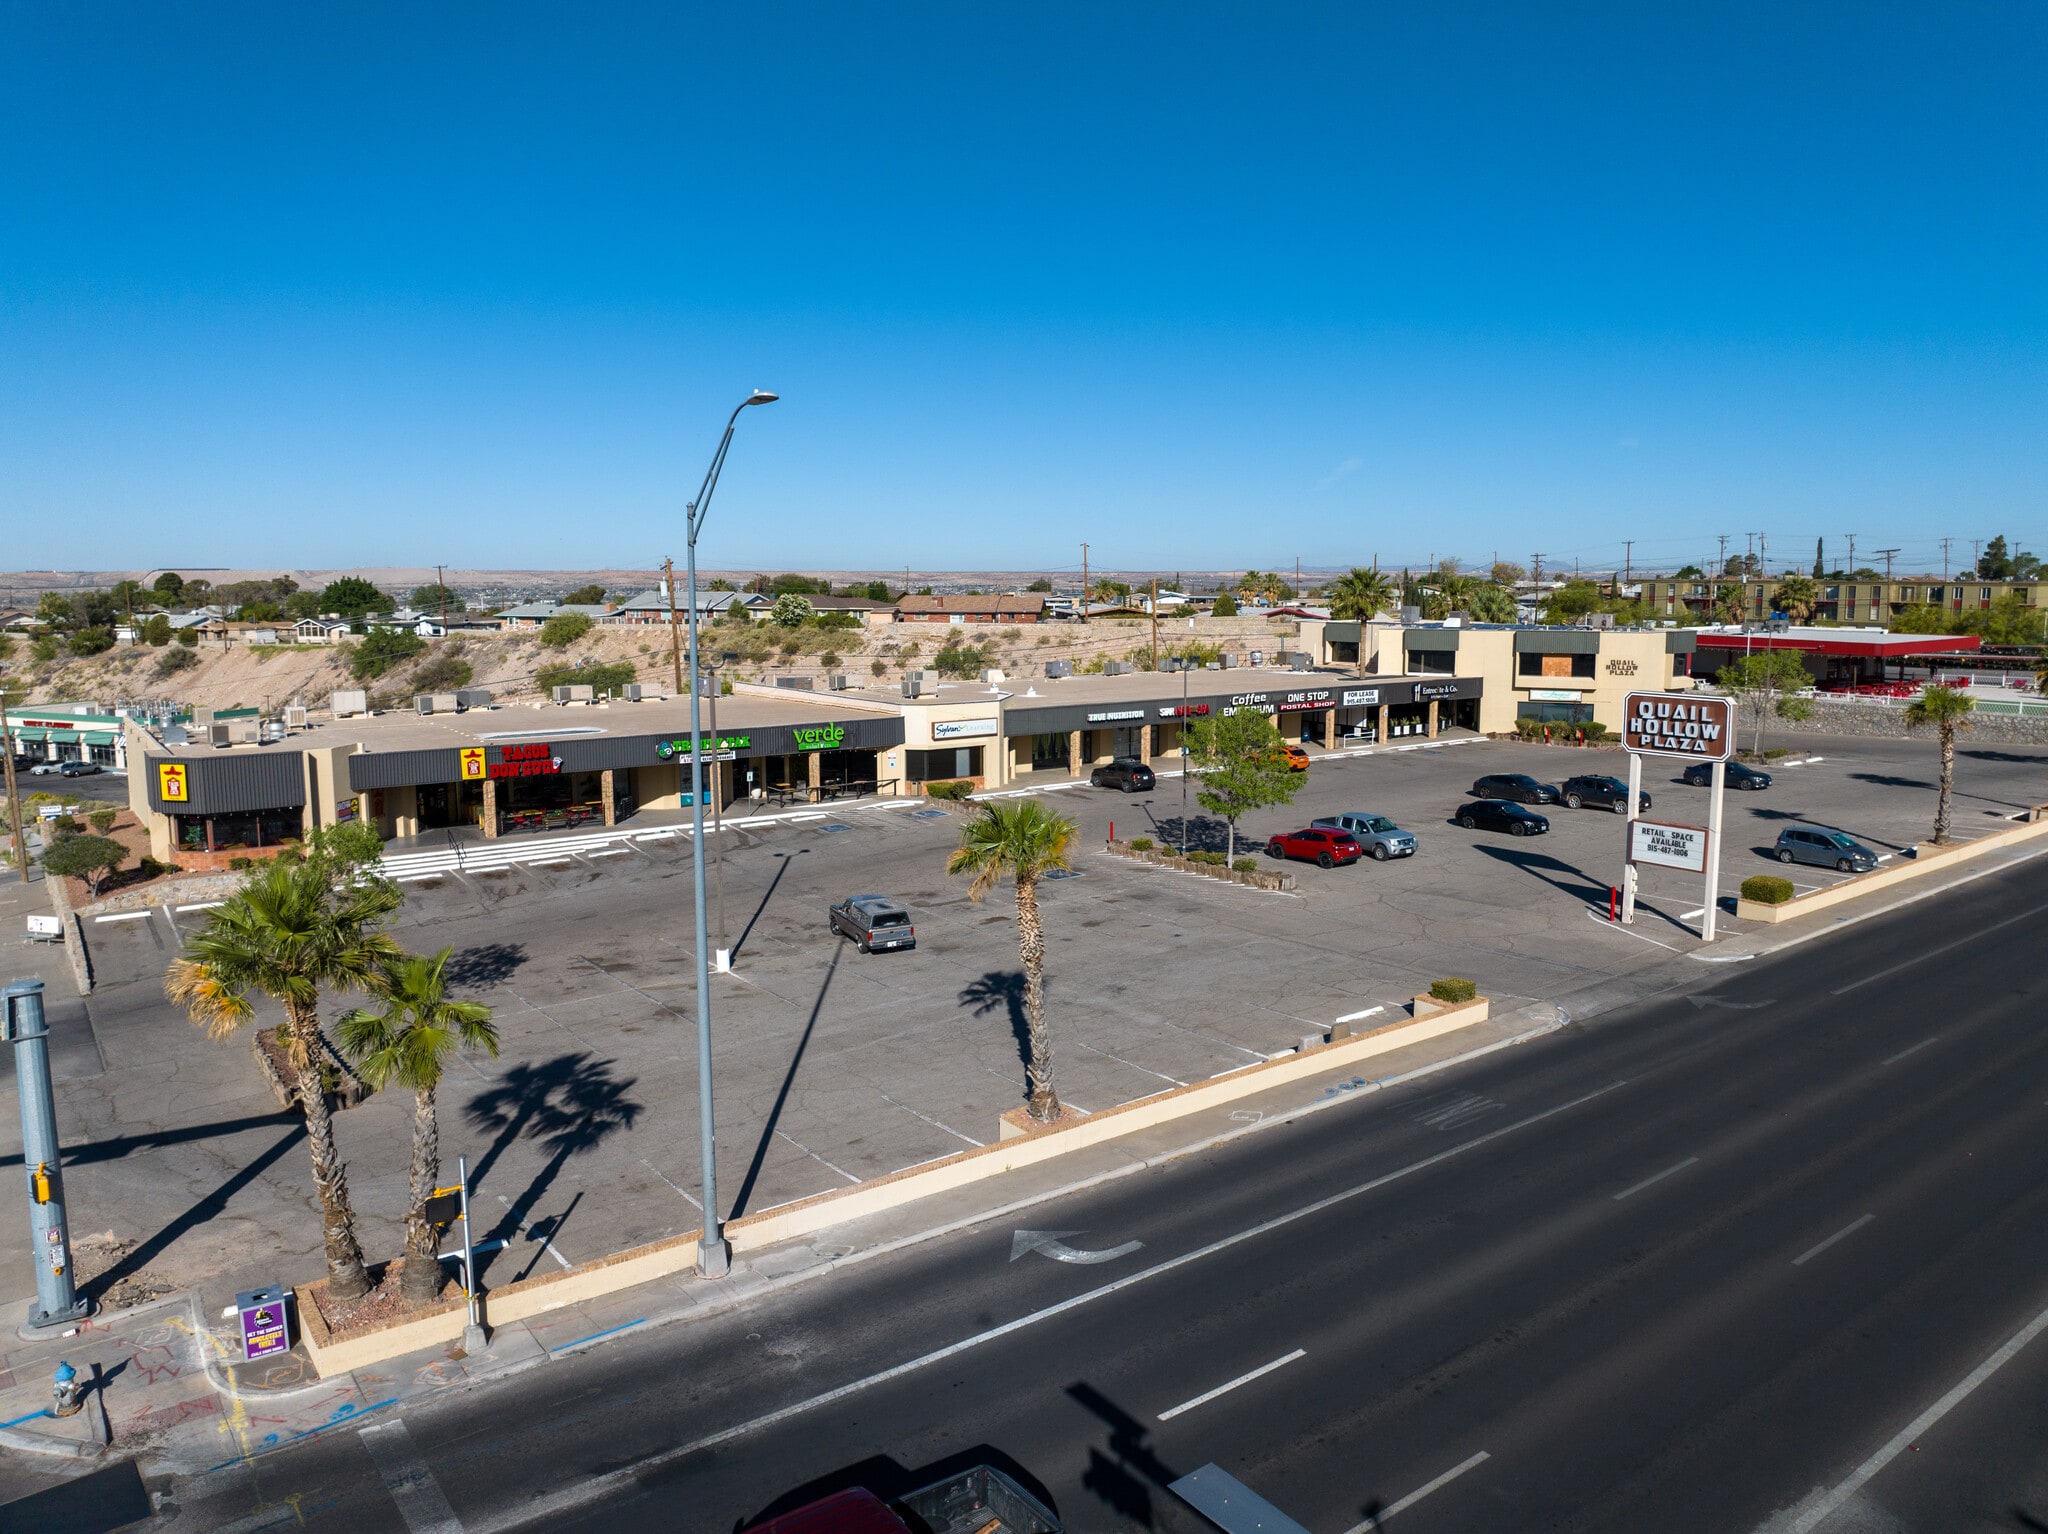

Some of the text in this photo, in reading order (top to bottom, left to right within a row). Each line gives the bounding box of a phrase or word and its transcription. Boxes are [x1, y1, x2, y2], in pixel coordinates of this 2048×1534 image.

[1232, 693, 1267, 705] Coffee
[1287, 691, 1329, 703] ONE STOP
[1281, 703, 1312, 711] POSTAL
[1639, 701, 1713, 722] QUAIL
[793, 722, 845, 744] verde
[936, 724, 960, 736] Sylvan
[1630, 718, 1721, 740] HOLLOW
[726, 736, 750, 748] TAX
[1641, 734, 1707, 751] PLAZA
[501, 743, 549, 761] TACOS
[489, 763, 520, 779] DON
[1641, 827, 1694, 842] RETAIL SPACE
[1651, 837, 1687, 849] AVAILABLE
[1647, 844, 1689, 857] 915-487-1806
